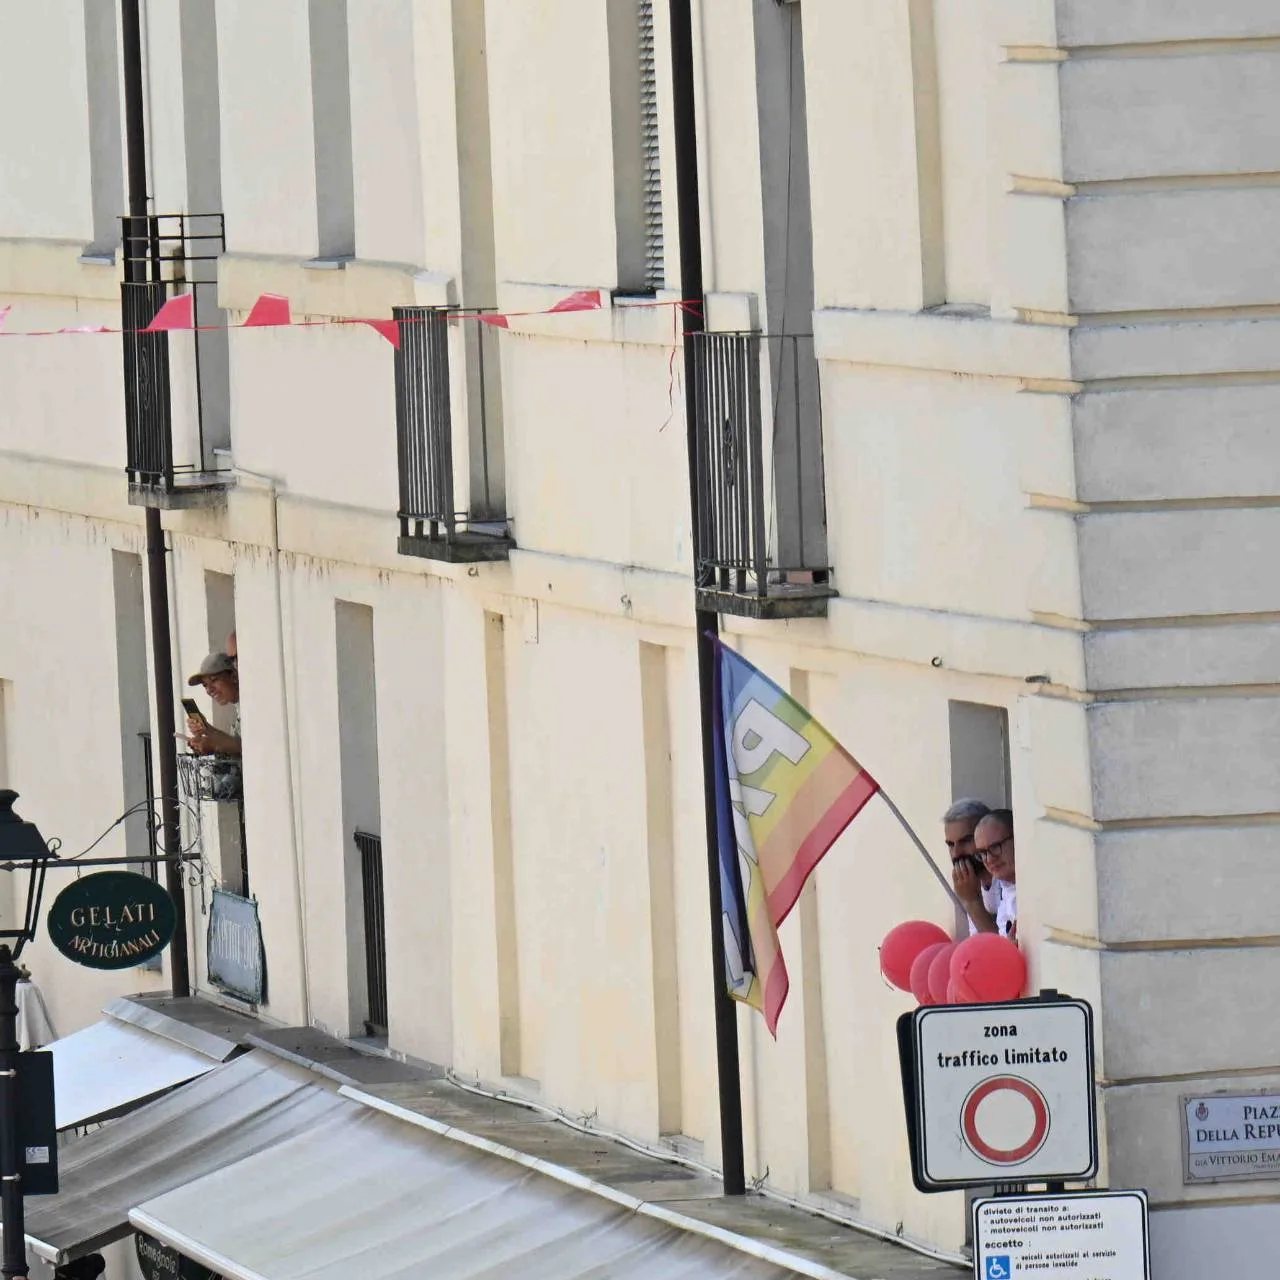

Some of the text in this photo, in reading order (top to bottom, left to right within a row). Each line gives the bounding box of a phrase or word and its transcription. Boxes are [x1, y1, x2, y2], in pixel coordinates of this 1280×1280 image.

[71, 903, 154, 927] GELATI
[68, 929, 160, 958] ARTIGIANALI
[984, 1024, 1018, 1038] zona
[937, 1047, 1068, 1068] traffico limitato
[1196, 1129, 1239, 1142] DELLA
[1209, 1153, 1257, 1165] VITTORIO
[1027, 1205, 1059, 1213] transito
[990, 1217, 1036, 1225] autoveicoli
[1058, 1213, 1101, 1221] autorizzati
[990, 1226, 1038, 1234] motoveicoli
[1060, 1222, 1104, 1231] autorizzati
[985, 1240, 1023, 1249] eccetto
[1045, 1252, 1080, 1260] autorizzati
[1092, 1250, 1116, 1258] servizio
[1052, 1261, 1078, 1269] invalide
